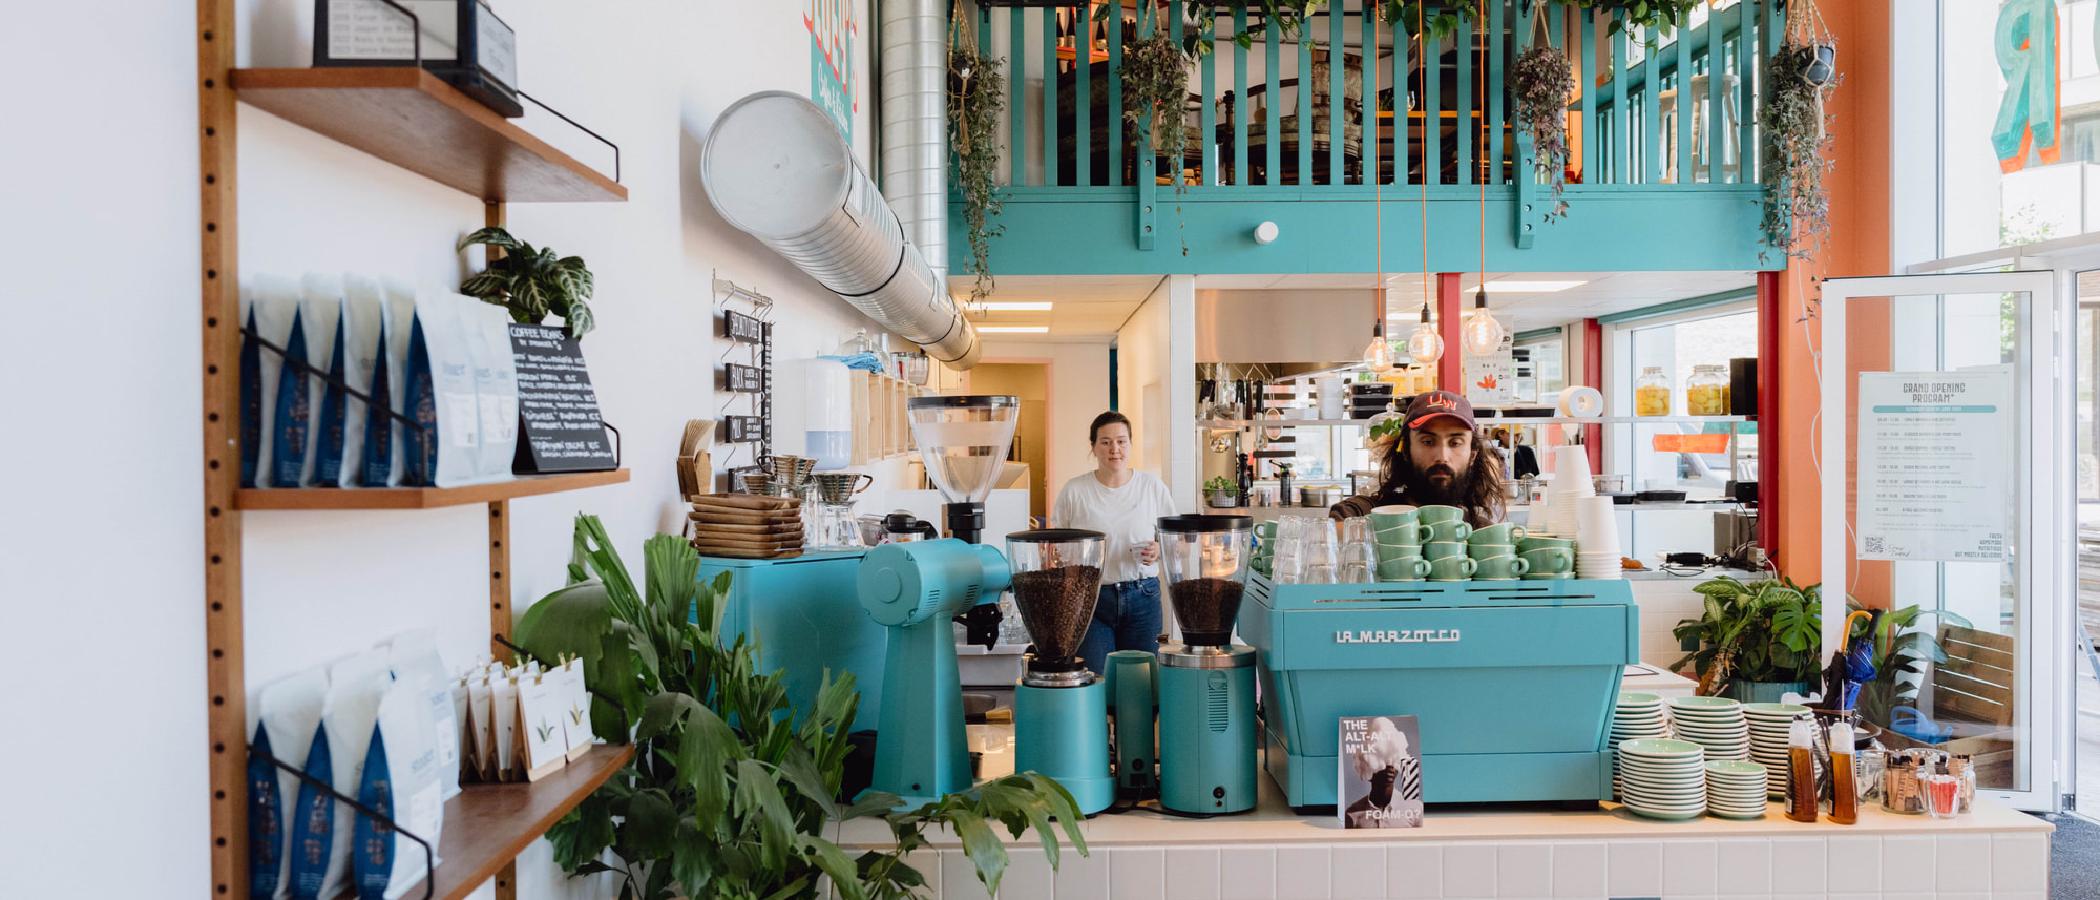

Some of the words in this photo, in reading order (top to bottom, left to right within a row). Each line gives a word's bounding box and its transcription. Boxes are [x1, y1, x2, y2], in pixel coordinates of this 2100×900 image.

[510, 327, 540, 338] COFFEE
[1903, 383, 1929, 393] GRAND
[1931, 382, 1966, 393] OPENING
[1336, 631, 1351, 643] LA
[1360, 629, 1460, 643] MARZOCCO
[1343, 720, 1368, 730] THE
